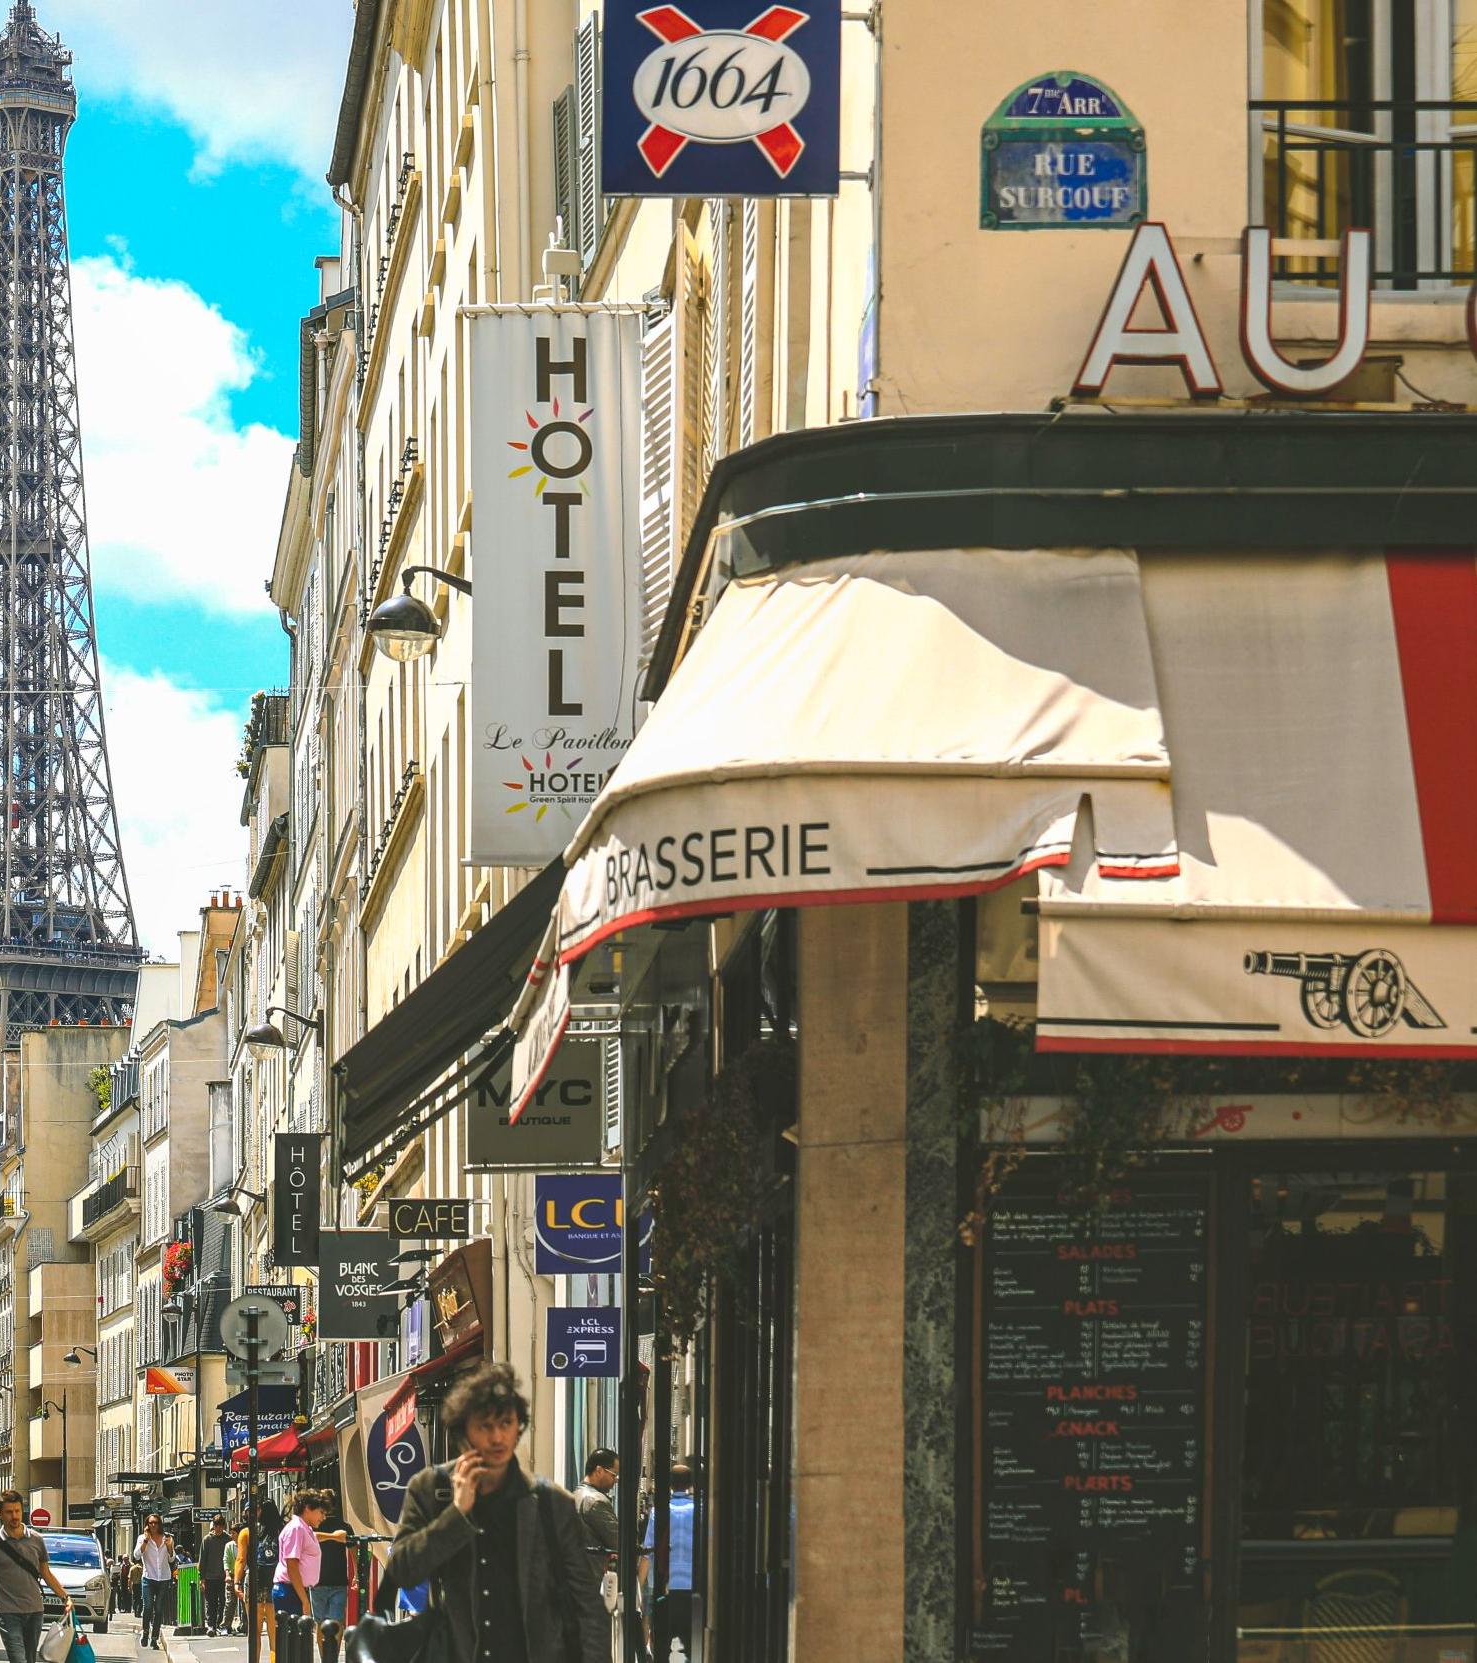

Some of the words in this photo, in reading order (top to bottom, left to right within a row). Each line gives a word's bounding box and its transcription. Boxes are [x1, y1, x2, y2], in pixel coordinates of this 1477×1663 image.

[651, 46, 793, 115] 1664
[1034, 153, 1096, 176] RUE
[999, 186, 1129, 209] SURCOUF
[1071, 222, 1372, 398] AU
[531, 336, 593, 716] HOTEL
[483, 722, 523, 750] Le
[532, 726, 634, 750] Pavillon
[529, 796, 556, 804] Green
[557, 795, 577, 805] Spirit
[605, 822, 831, 906] BRASSERIE
[499, 1116, 572, 1126] BUTIQUE
[289, 1146, 306, 1254] HÔTEL
[395, 1204, 466, 1234] CAFE
[1056, 1245, 1136, 1260] SALADES
[339, 1262, 380, 1277] BLANC
[351, 1276, 366, 1284] DES
[247, 1287, 298, 1297] RESTAURANT
[1064, 1300, 1118, 1315] PLATS
[566, 1326, 615, 1334] EXPRESS
[1046, 1385, 1137, 1400] PLANCHES
[224, 1410, 297, 1422] Resurant
[232, 1422, 291, 1435] Jaonais
